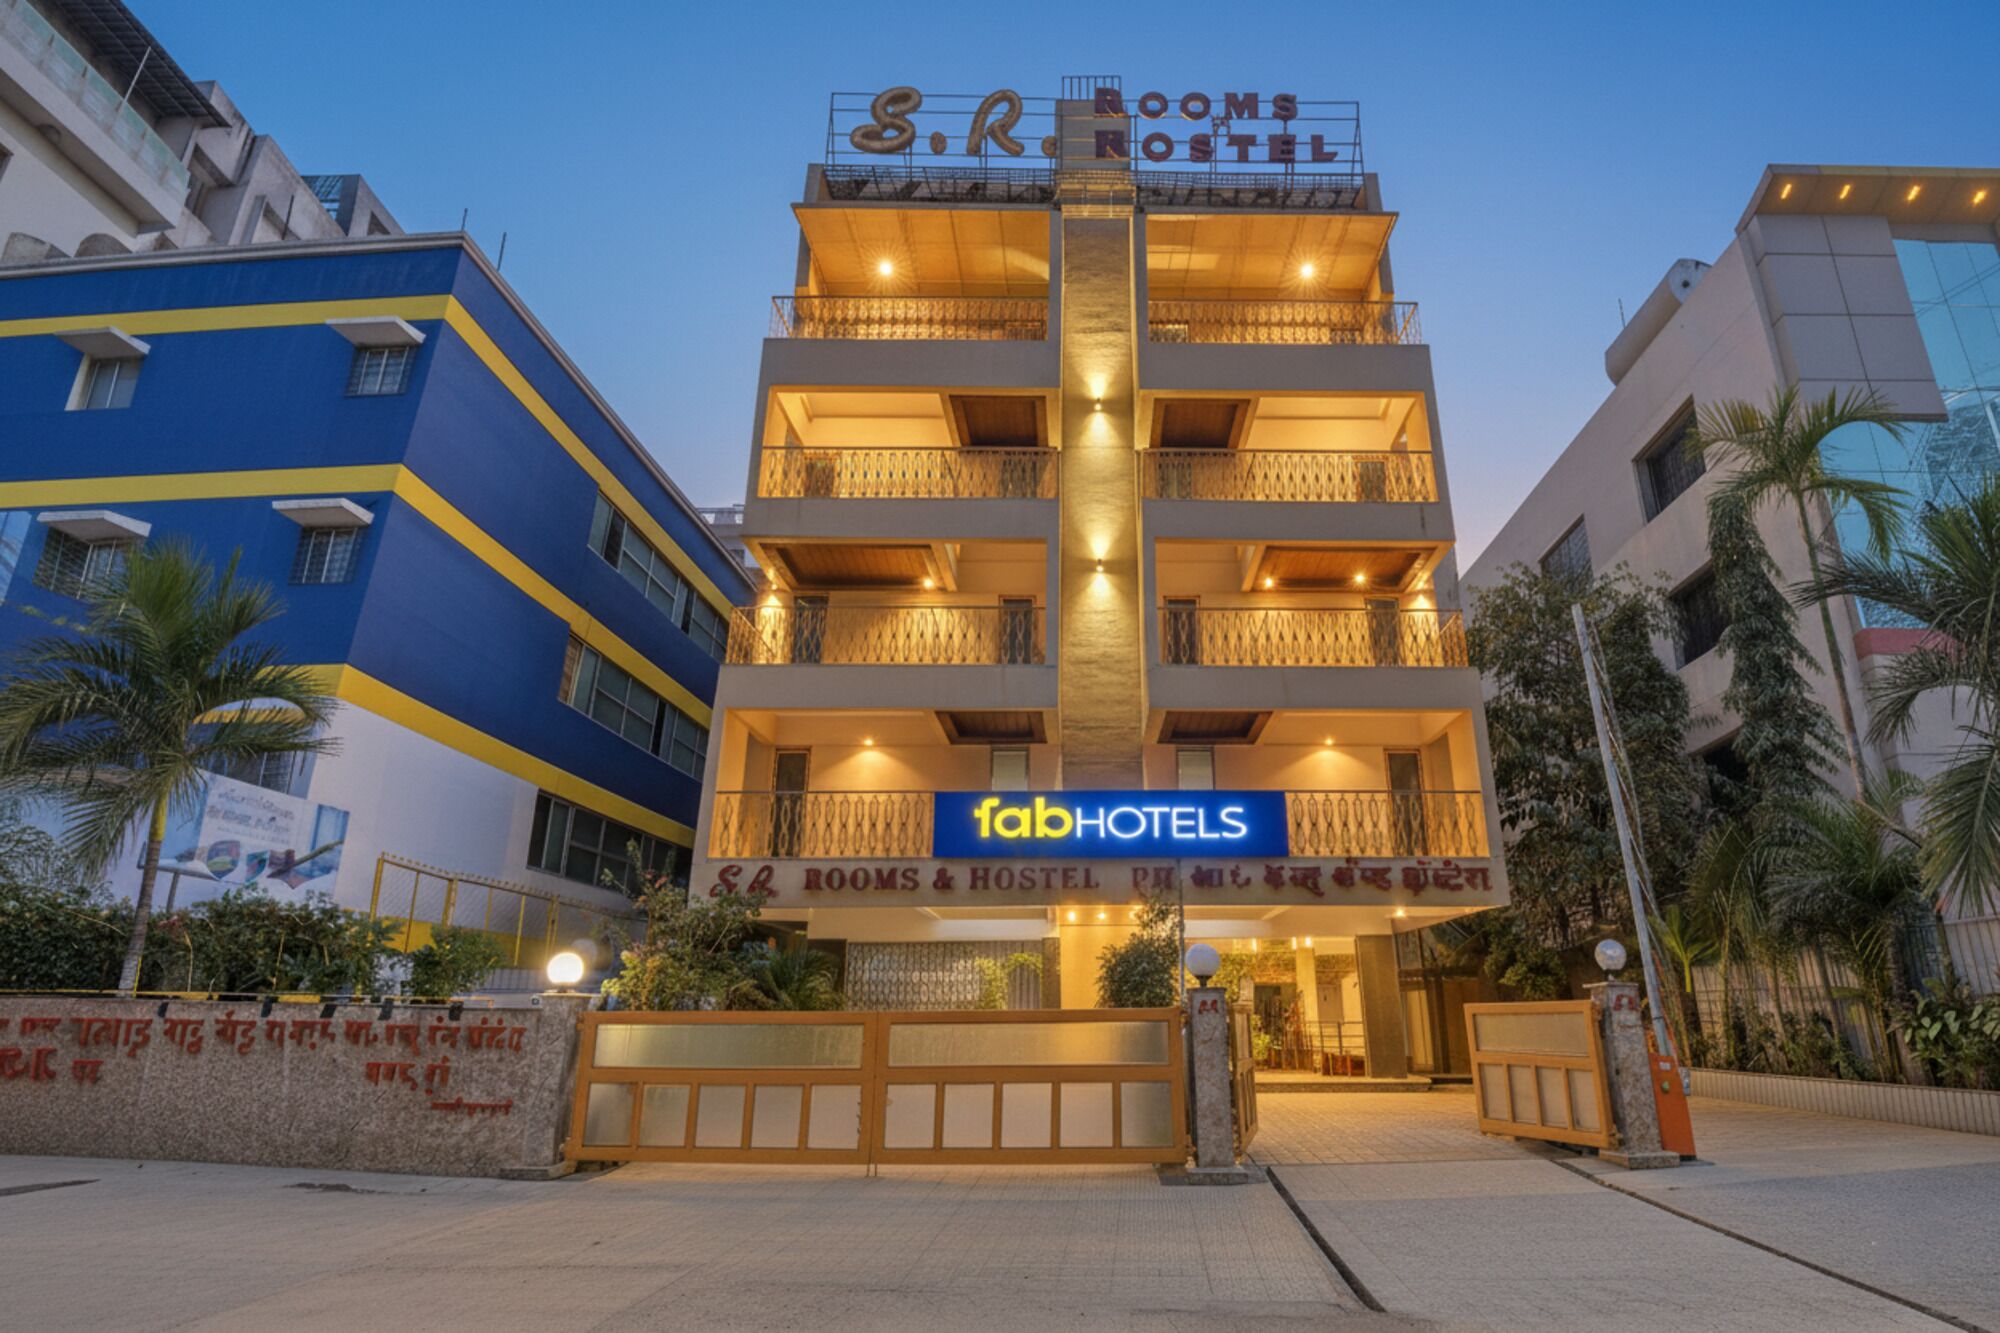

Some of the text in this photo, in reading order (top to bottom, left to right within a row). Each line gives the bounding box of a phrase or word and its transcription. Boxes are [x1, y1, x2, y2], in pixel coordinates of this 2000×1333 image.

[1094, 87, 1298, 121] ROOMS
[804, 867, 920, 892] ROOMS
[932, 867, 955, 891] &
[969, 866, 1099, 891] HOSTEL
